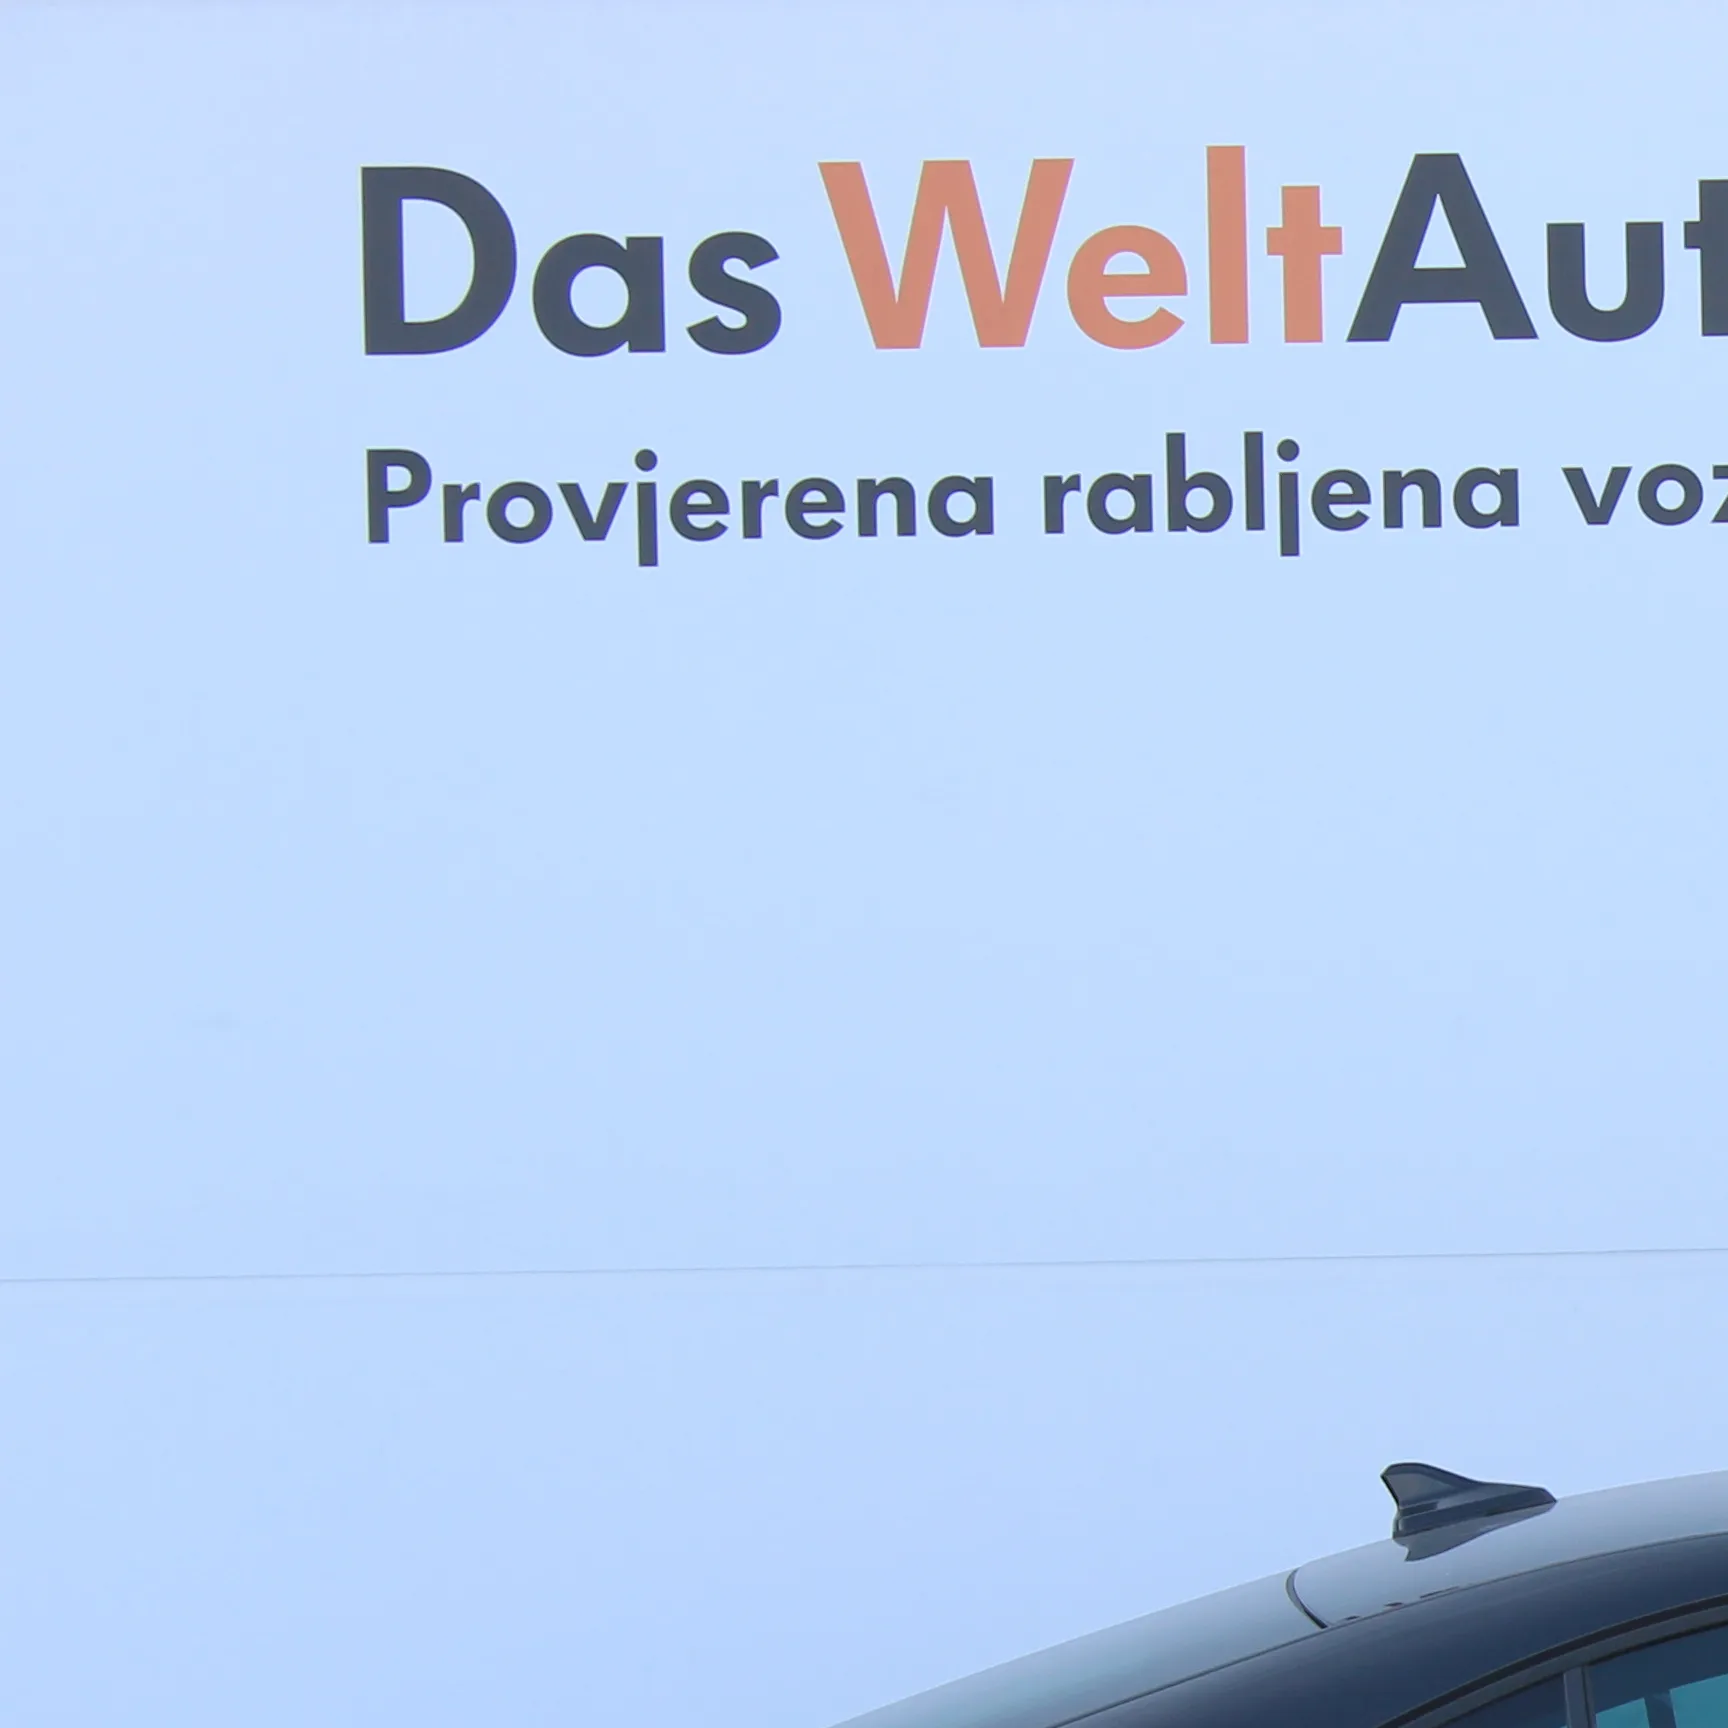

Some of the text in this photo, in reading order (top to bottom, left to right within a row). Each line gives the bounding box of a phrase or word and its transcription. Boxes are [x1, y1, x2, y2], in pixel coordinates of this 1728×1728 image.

[361, 166, 782, 358] Das
[366, 448, 995, 568] Provjerena
[1043, 430, 1520, 558] rabljena
